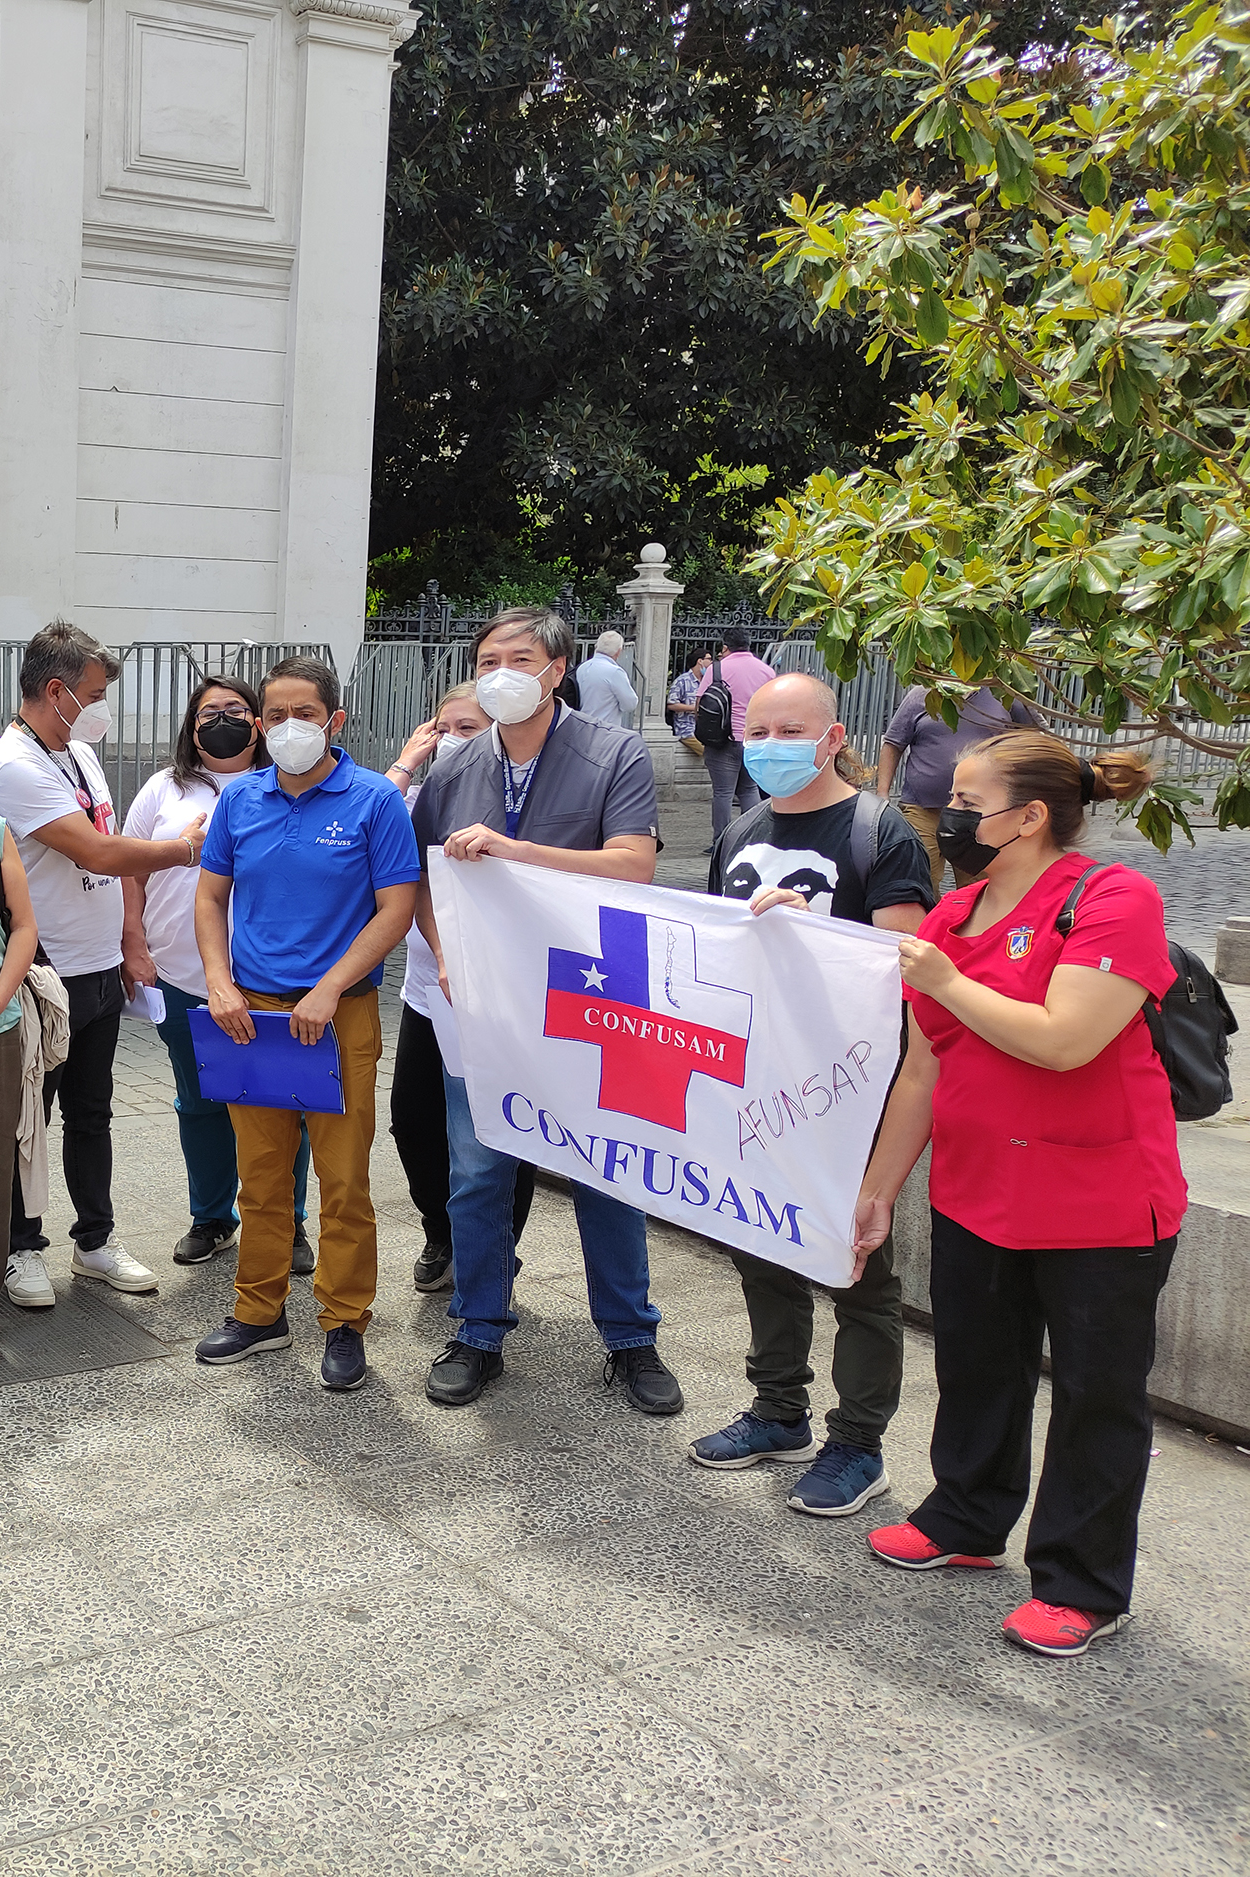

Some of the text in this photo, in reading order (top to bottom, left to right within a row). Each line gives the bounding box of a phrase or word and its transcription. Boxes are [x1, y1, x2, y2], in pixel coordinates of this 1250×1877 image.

[315, 837, 352, 846] Fenpruss
[82, 876, 96, 891] Por
[583, 1007, 726, 1063] CONFUSAM
[736, 1040, 872, 1161] AFUNSAP
[501, 1091, 805, 1248] CONFUSAM
